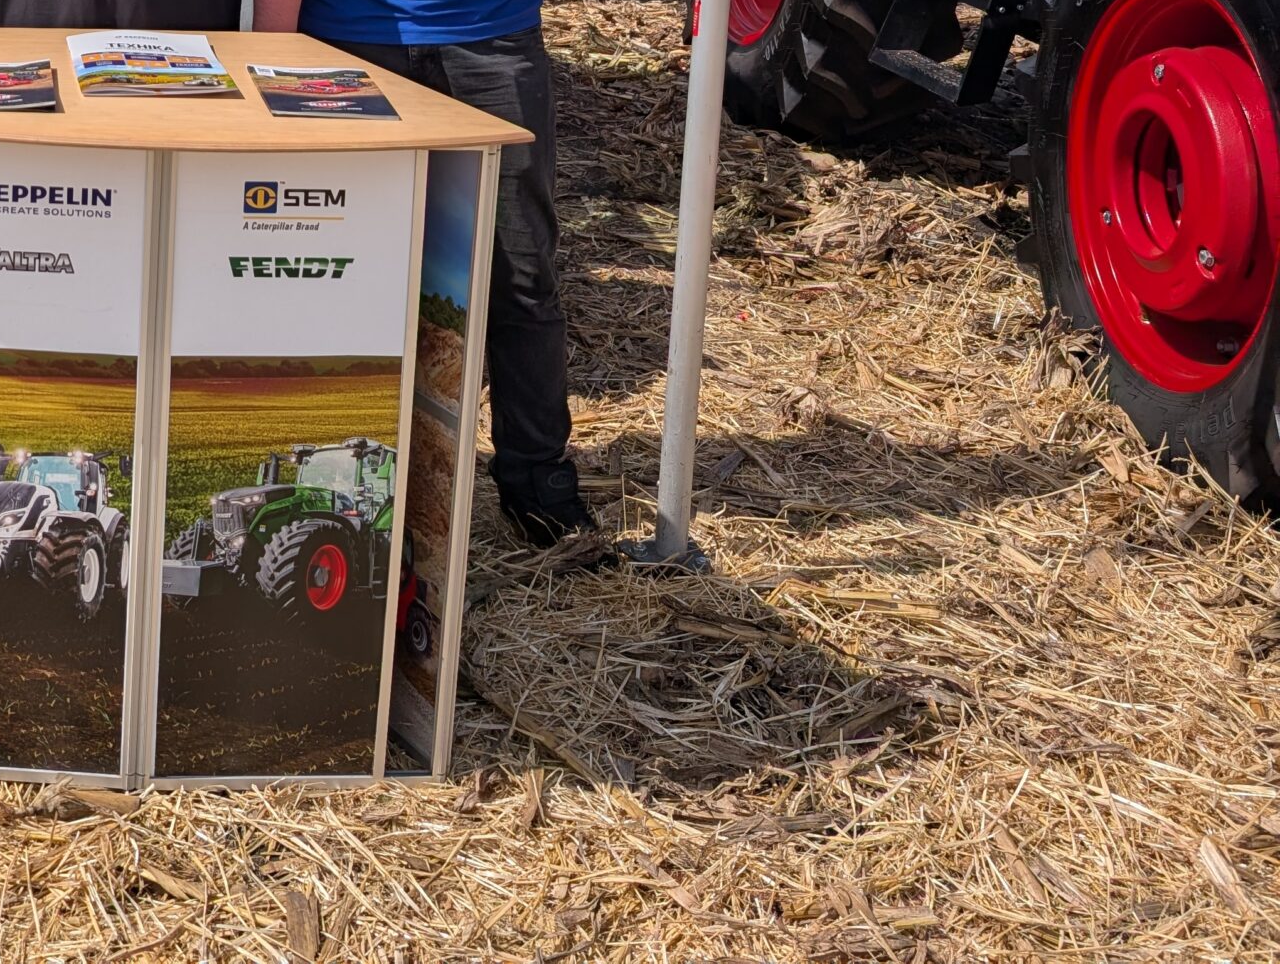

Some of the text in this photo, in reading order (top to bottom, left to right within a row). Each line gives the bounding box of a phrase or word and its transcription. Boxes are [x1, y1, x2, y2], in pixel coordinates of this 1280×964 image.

[283, 189, 346, 208] SEM
[43, 207, 112, 218] SOLUTIONS
[243, 221, 320, 233] A Caterpillar Brand
[228, 256, 355, 279] FENDT
